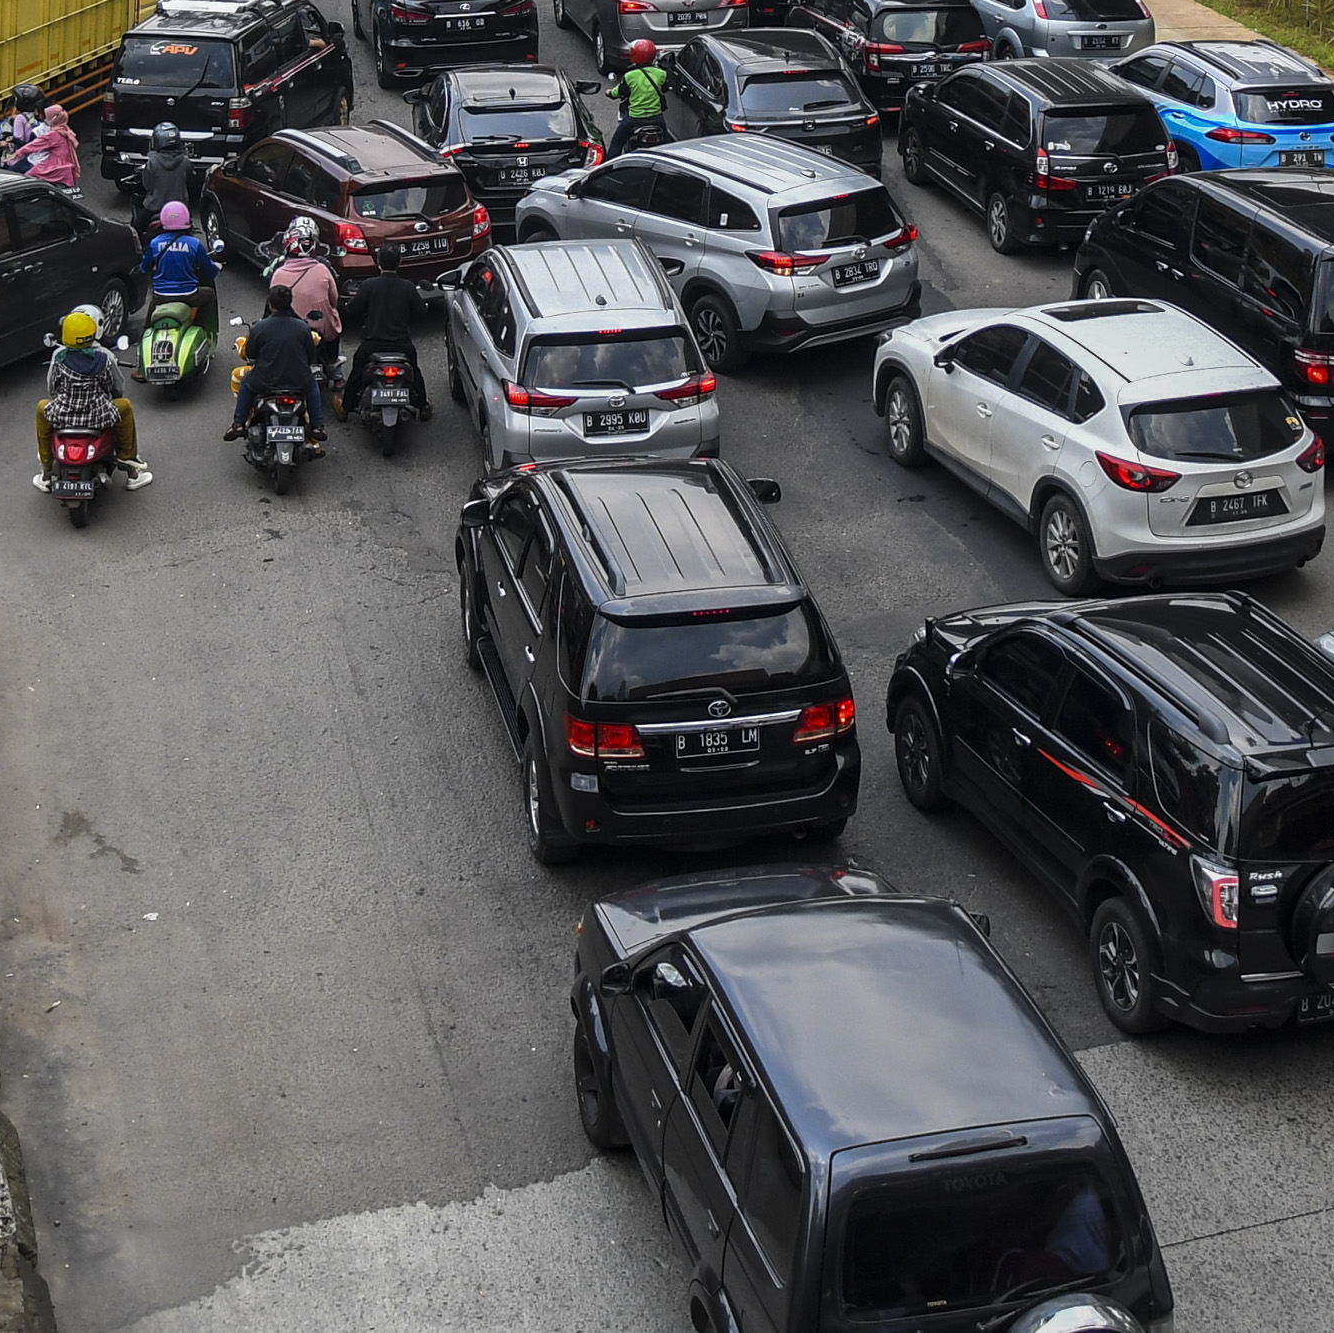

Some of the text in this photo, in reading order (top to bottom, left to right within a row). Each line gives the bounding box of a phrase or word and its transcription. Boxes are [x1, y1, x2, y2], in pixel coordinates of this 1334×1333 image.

[162, 45, 198, 55] APV
[1266, 99, 1323, 110] HYDRO
[1281, 153, 1286, 162] B
[1293, 152, 1307, 162] 291
[510, 169, 528, 178] 2426
[1087, 184, 1115, 196] B 1219
[400, 244, 406, 253] B
[412, 241, 431, 252] 2258
[835, 270, 841, 280] B
[844, 265, 863, 278] 2834
[586, 413, 624, 427] B 2995
[1210, 495, 1268, 513] B 2467 TFK
[677, 726, 759, 751] B 1835 LM
[1249, 870, 1284, 882] Rush
[1301, 997, 1309, 1012] B
